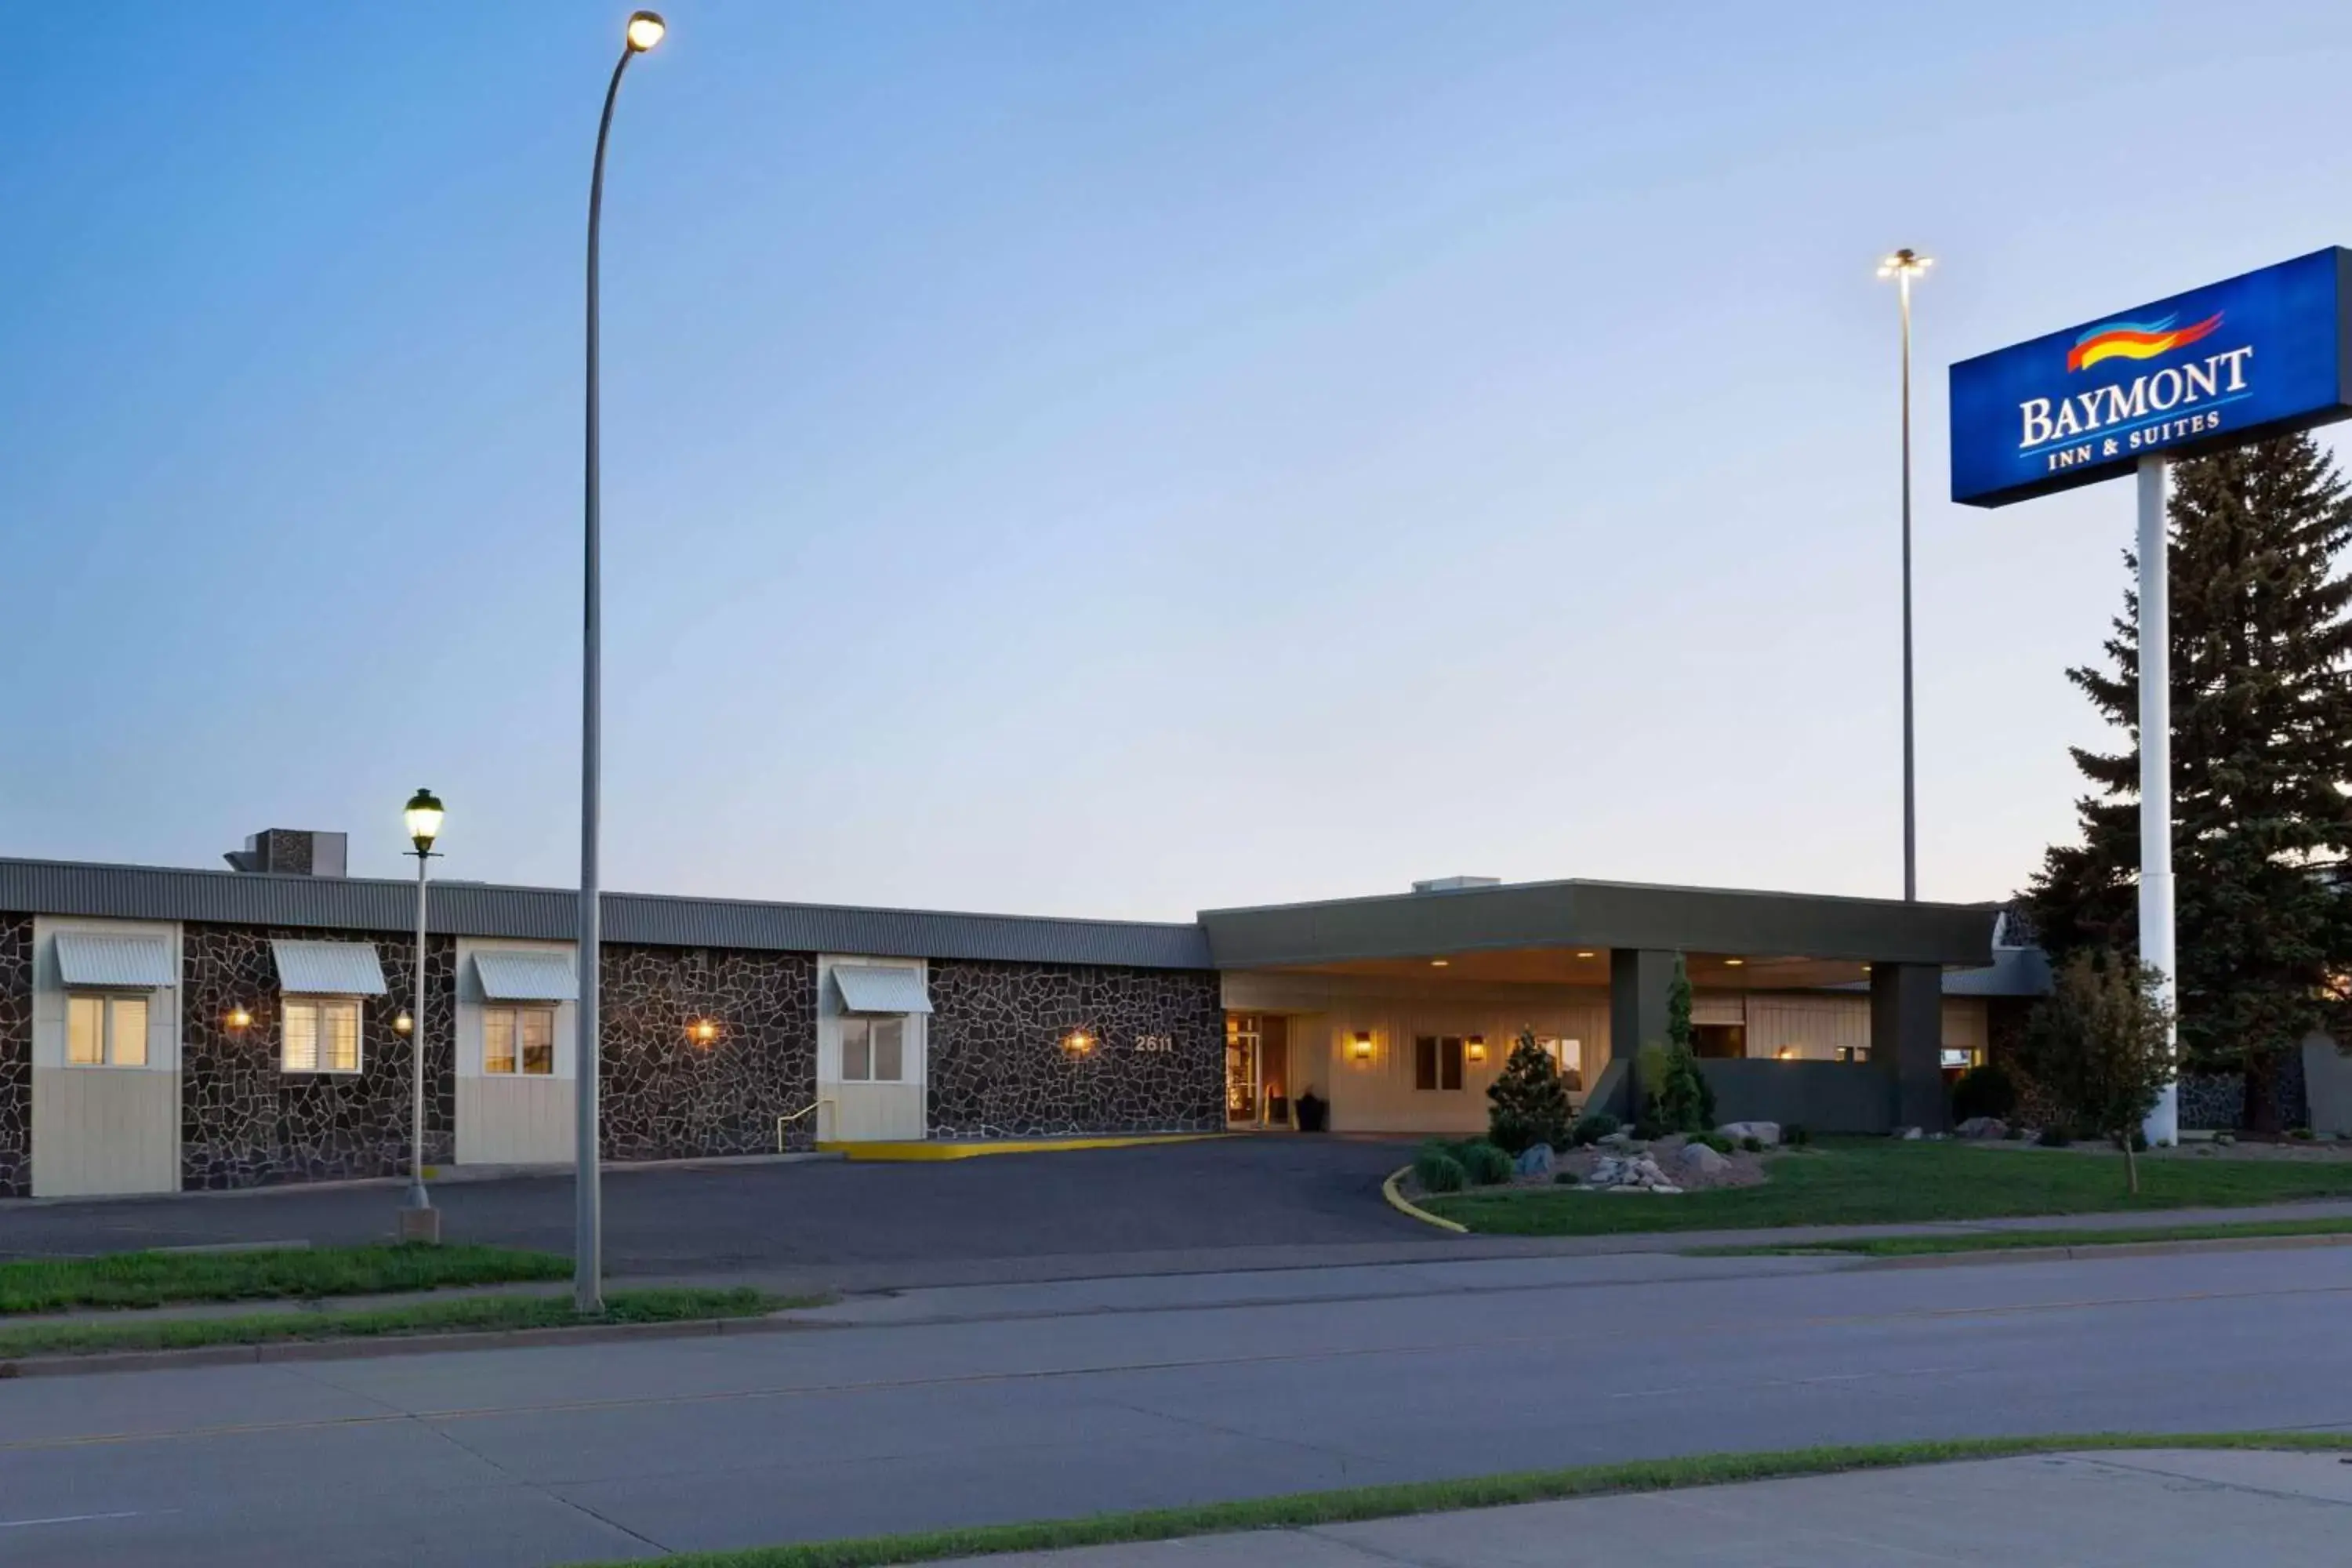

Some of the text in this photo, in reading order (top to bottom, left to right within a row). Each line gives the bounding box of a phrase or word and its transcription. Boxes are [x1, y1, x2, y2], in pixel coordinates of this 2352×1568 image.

[2019, 345, 2253, 448] BAYMONT
[2048, 410, 2220, 470] INN & SUITES
[1134, 1036, 1173, 1051] 2611
